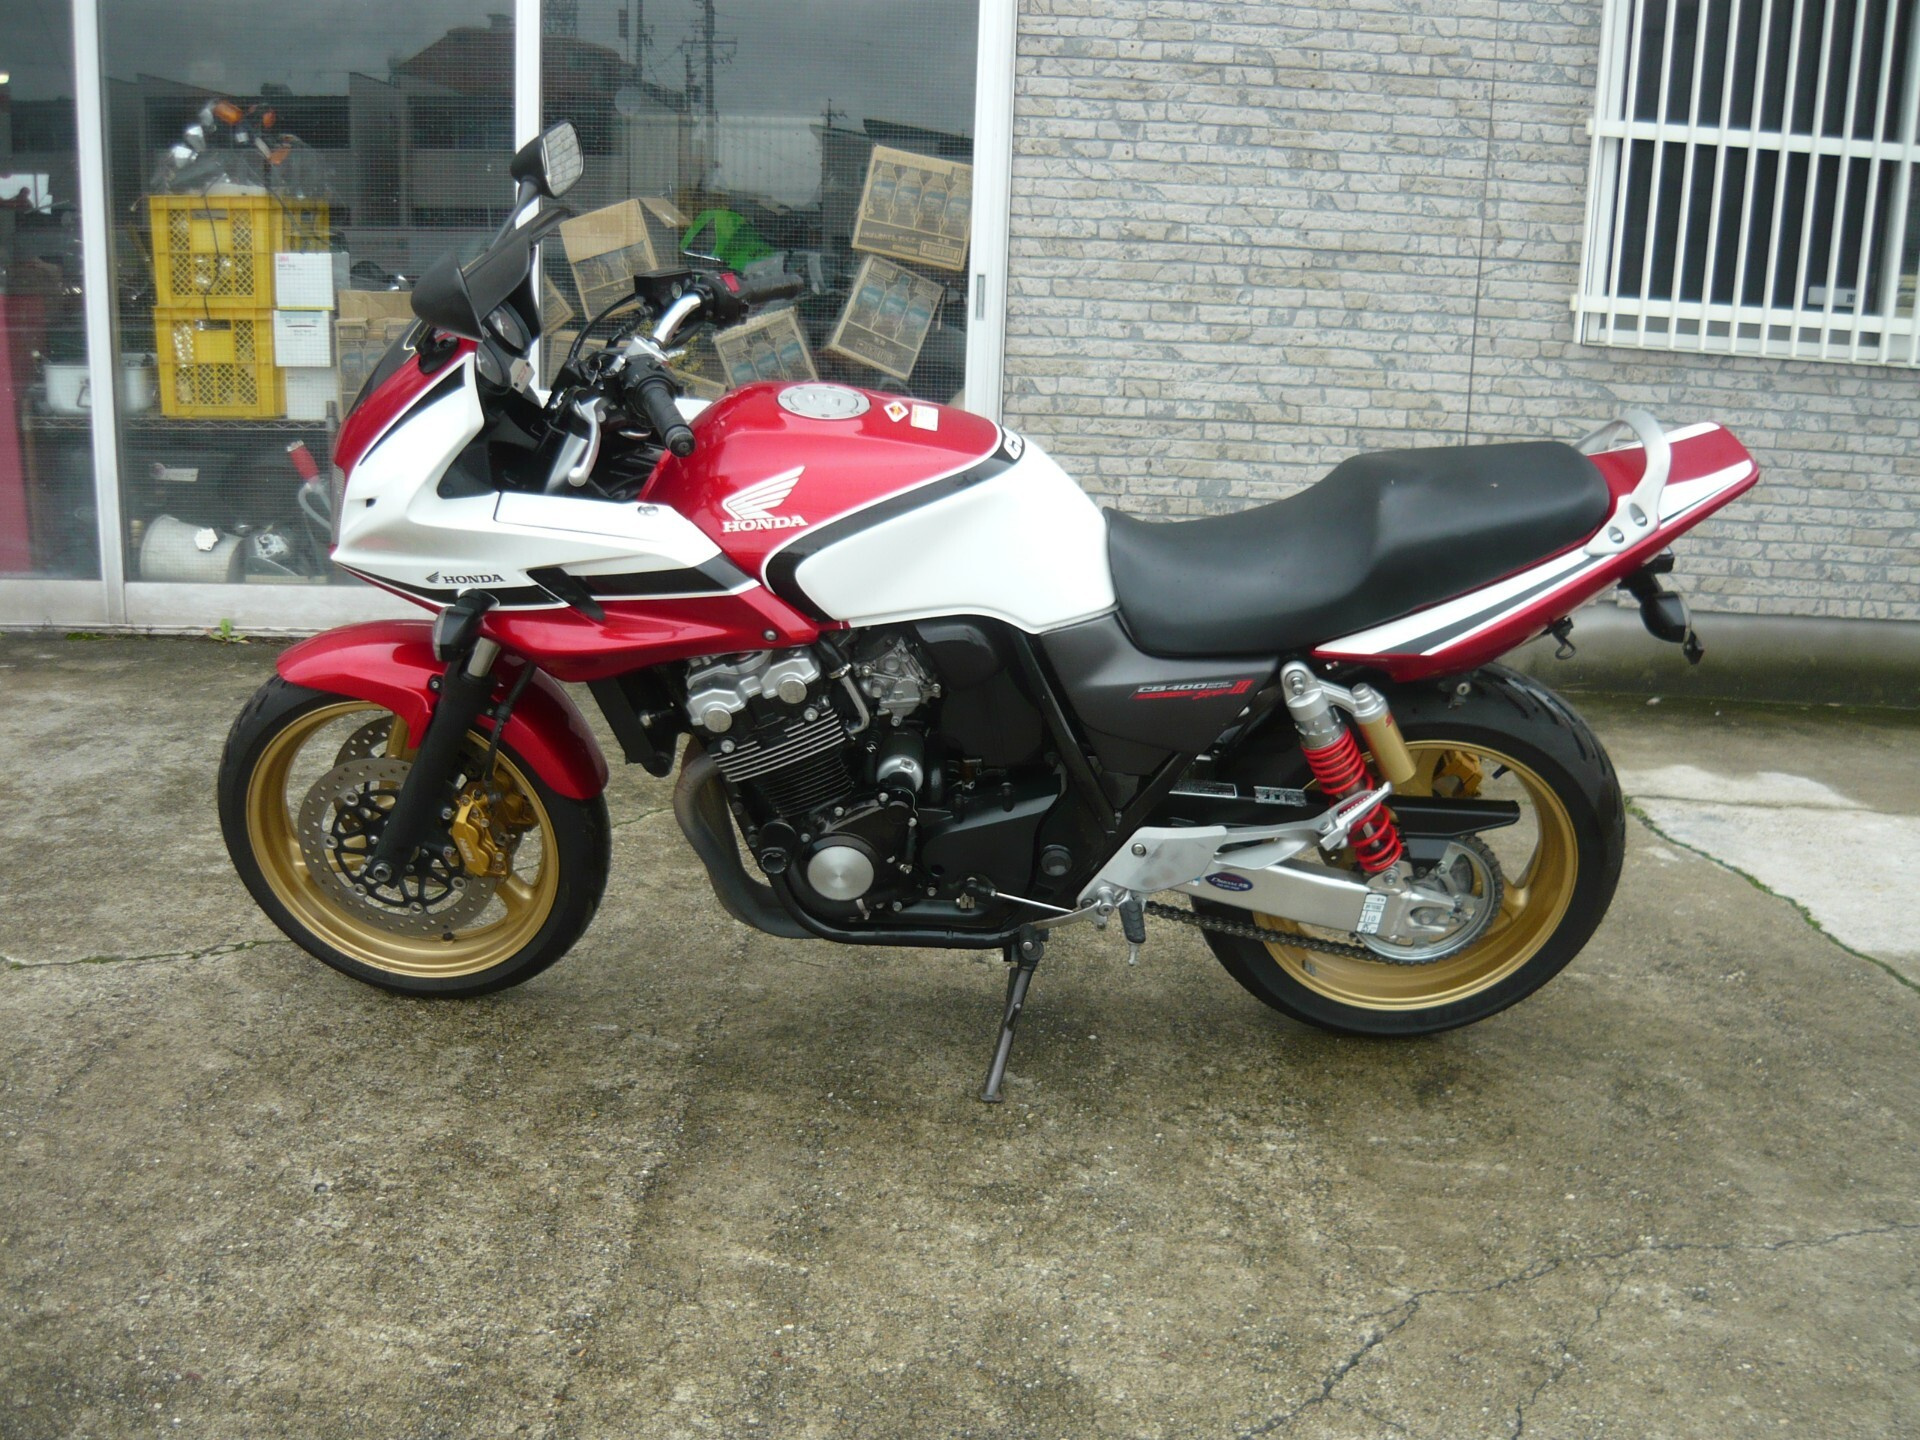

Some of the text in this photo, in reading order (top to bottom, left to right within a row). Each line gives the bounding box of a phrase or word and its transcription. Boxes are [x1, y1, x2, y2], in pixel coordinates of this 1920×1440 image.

[722, 515, 808, 533] HONDA
[442, 574, 506, 584] HONDA
[1137, 683, 1208, 693] CB400
